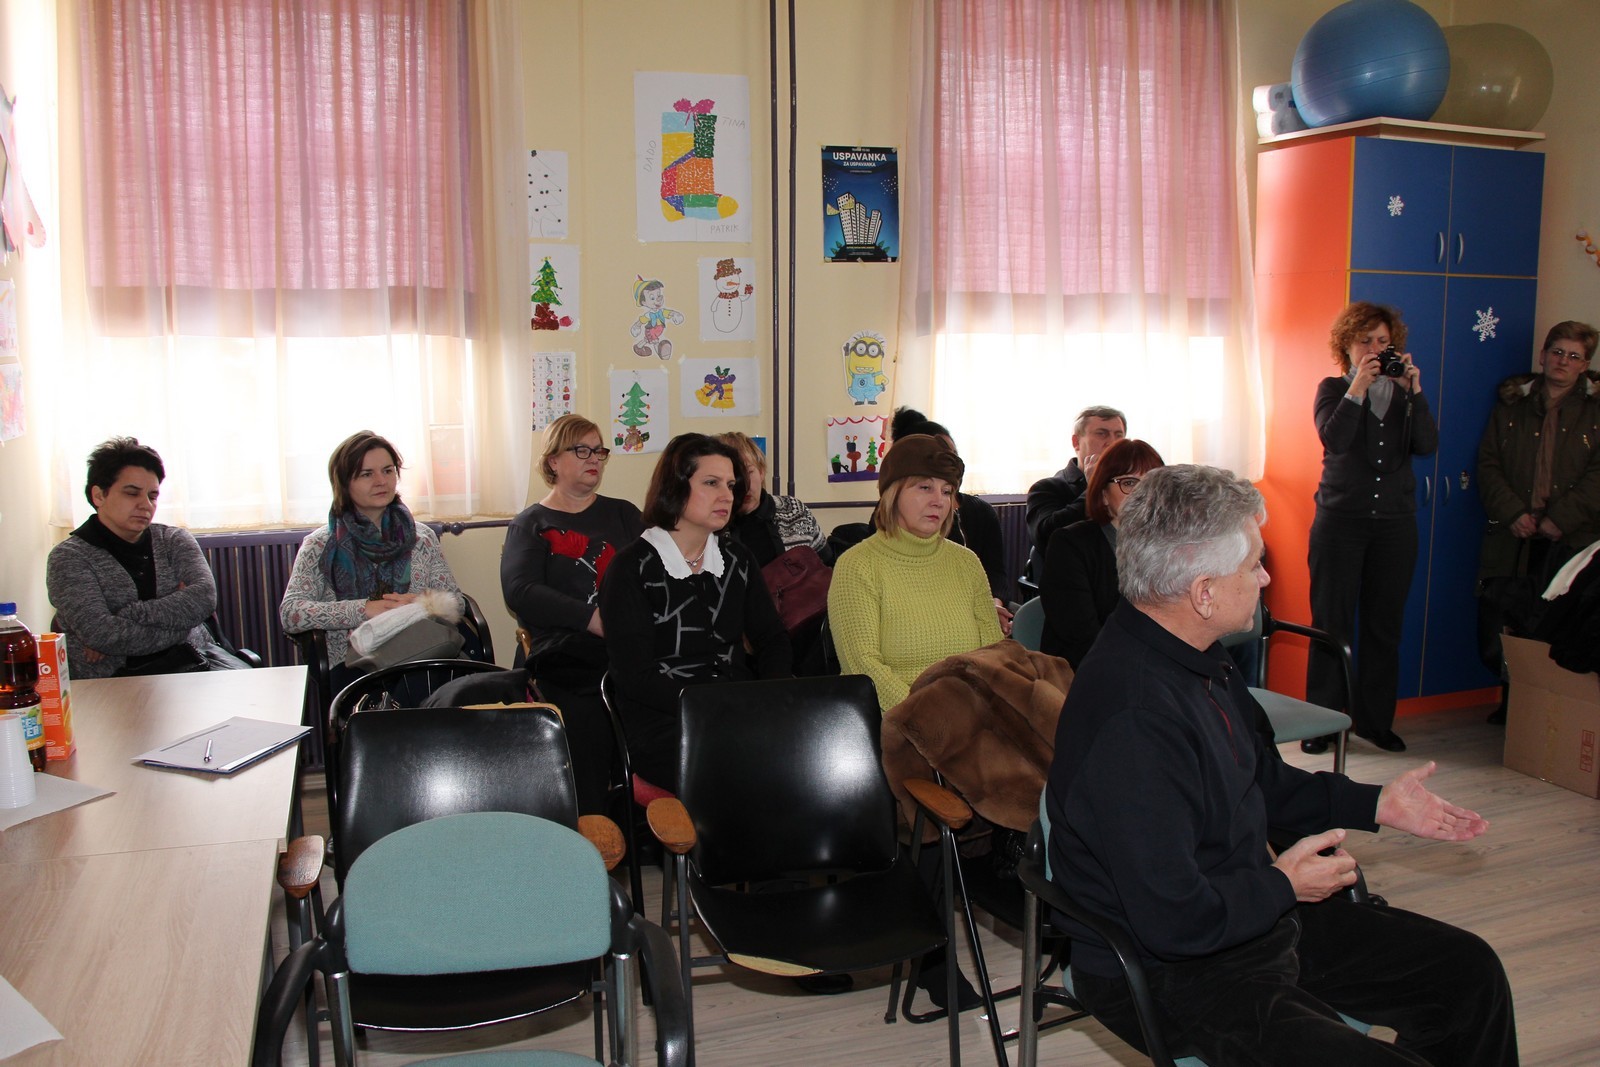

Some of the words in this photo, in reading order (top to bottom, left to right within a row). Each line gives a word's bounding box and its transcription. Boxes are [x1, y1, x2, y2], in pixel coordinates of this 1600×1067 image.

[721, 116, 746, 129] TINA
[643, 139, 657, 172] DADO
[832, 152, 887, 161] USPAVANKA
[710, 224, 739, 234] PATRIK
